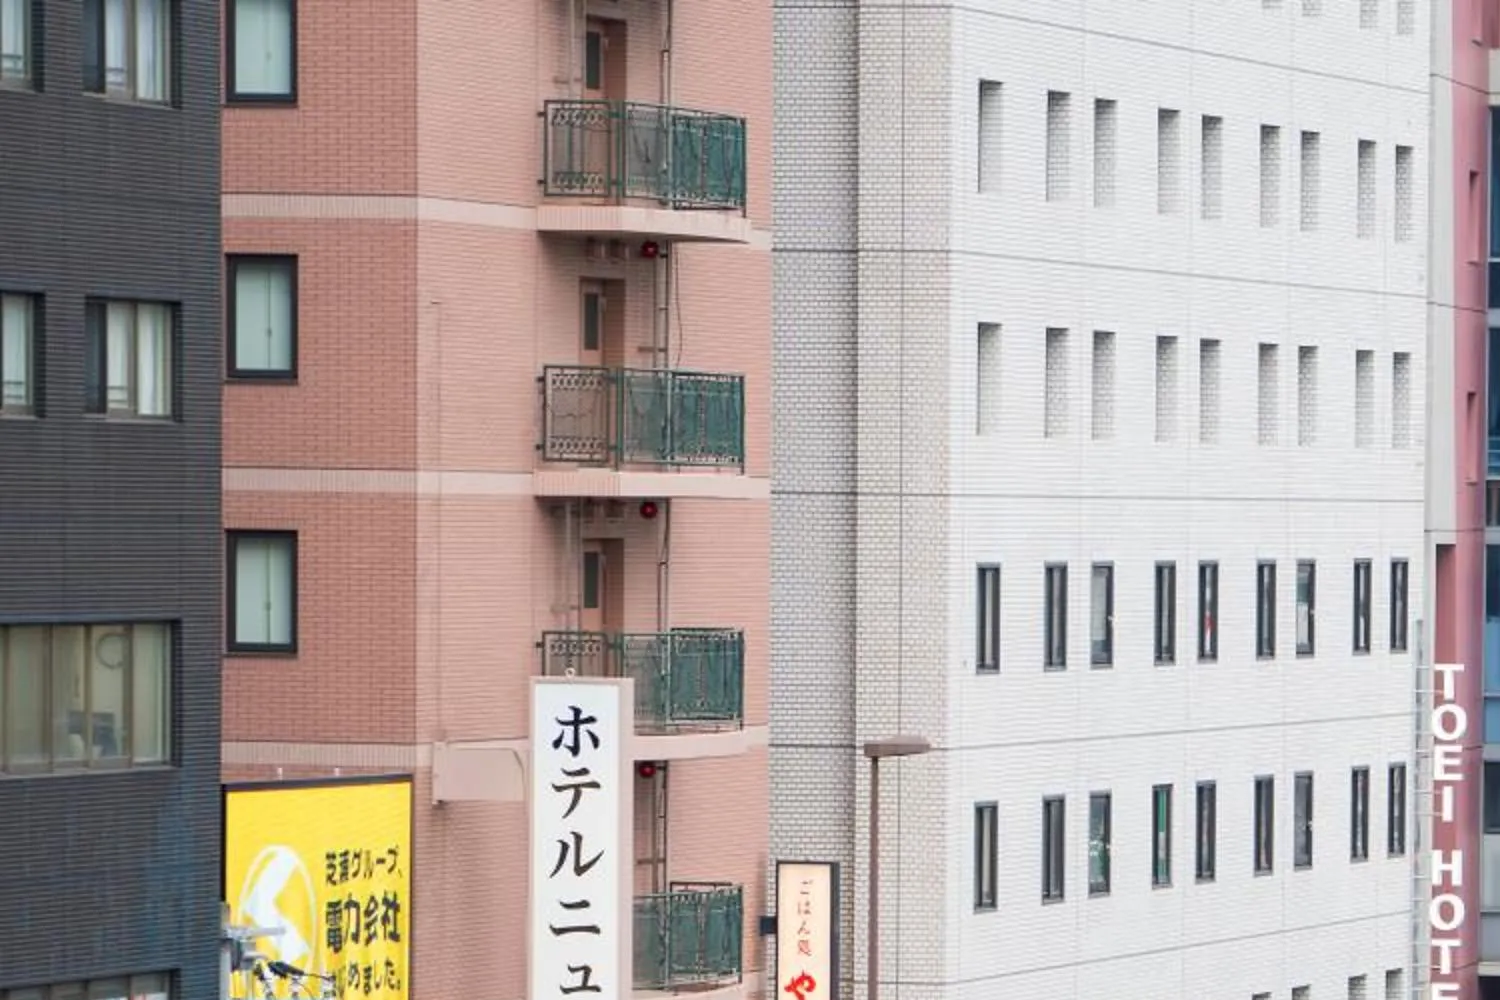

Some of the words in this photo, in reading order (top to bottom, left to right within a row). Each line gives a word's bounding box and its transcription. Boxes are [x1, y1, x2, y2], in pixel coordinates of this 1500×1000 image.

[1431, 664, 1467, 822] TOEI
[325, 891, 401, 952] 電力会社
